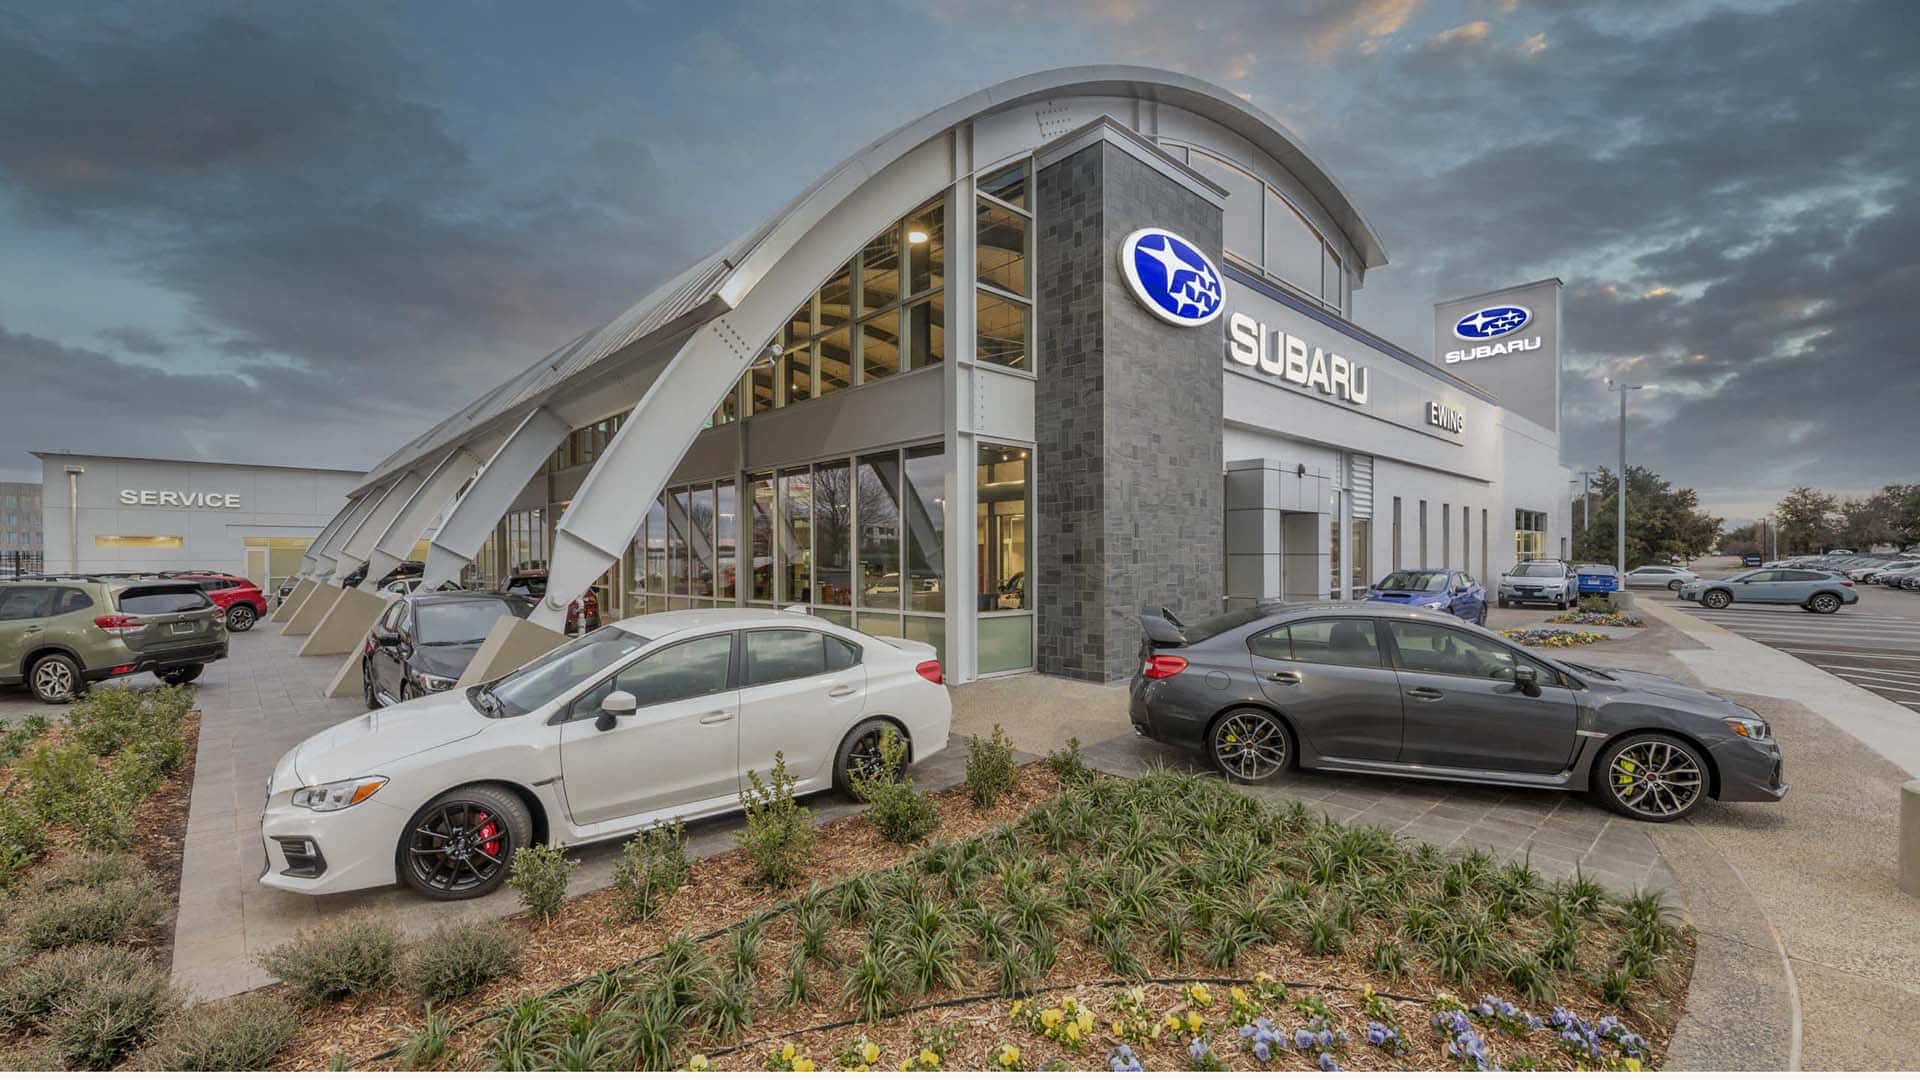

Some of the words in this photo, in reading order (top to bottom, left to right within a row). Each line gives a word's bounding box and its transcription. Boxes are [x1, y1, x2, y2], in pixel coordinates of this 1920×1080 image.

[1229, 312, 1367, 404] SUBARU
[1444, 336, 1541, 364] SUBARU
[1430, 401, 1464, 433] EWING
[119, 489, 241, 508] SERVICE
